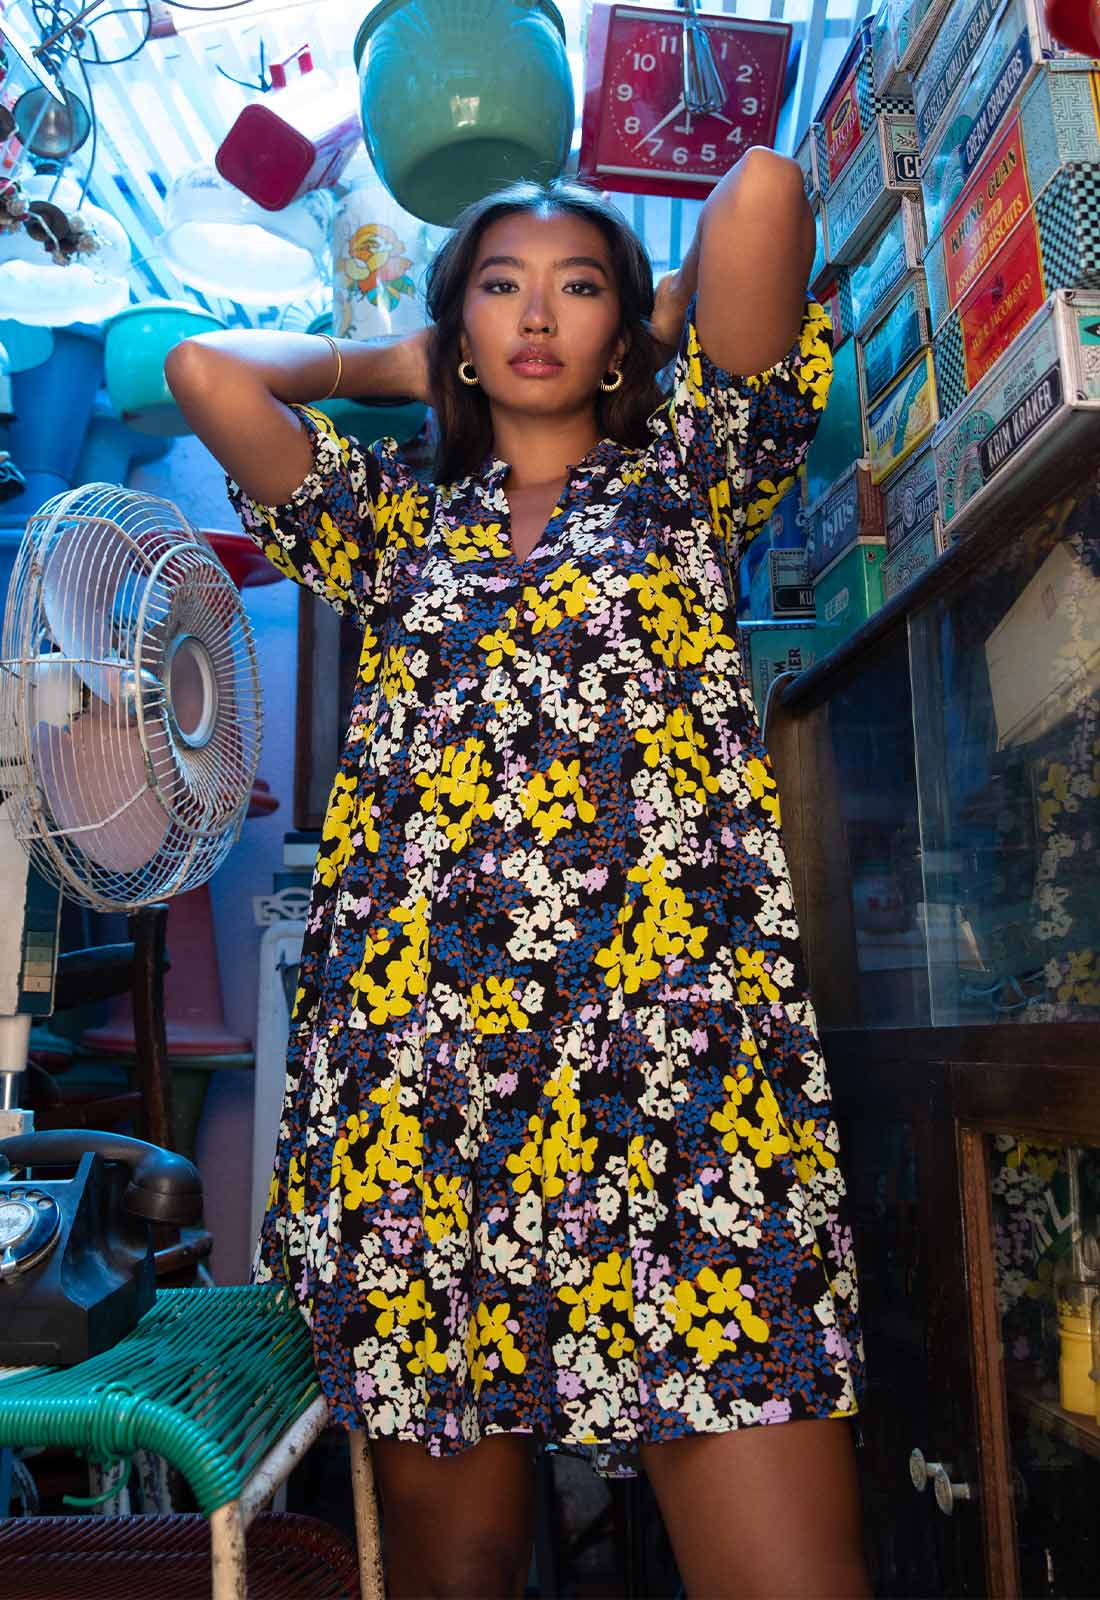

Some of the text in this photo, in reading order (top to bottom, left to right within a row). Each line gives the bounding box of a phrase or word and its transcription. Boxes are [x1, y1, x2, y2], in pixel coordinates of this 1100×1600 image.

[967, 7, 990, 49] CREAM
[660, 35, 678, 55] 11
[720, 42, 728, 60] 1
[632, 53, 656, 73] 10
[736, 65, 753, 83] 2
[617, 84, 633, 102] 9
[741, 97, 758, 115] 3
[967, 48, 1023, 165] CREAM CRACKERS
[624, 116, 641, 134] 8
[726, 127, 742, 144] 4
[648, 138, 664, 156] 7
[672, 147, 688, 165] 6
[700, 144, 717, 162] 5
[951, 145, 1016, 254] KHONG GUAN
[969, 198, 1003, 250] SELECTED
[987, 193, 1025, 251] BISCUITS
[987, 421, 1014, 467] KRIM
[1012, 380, 1054, 442] KRAKER
